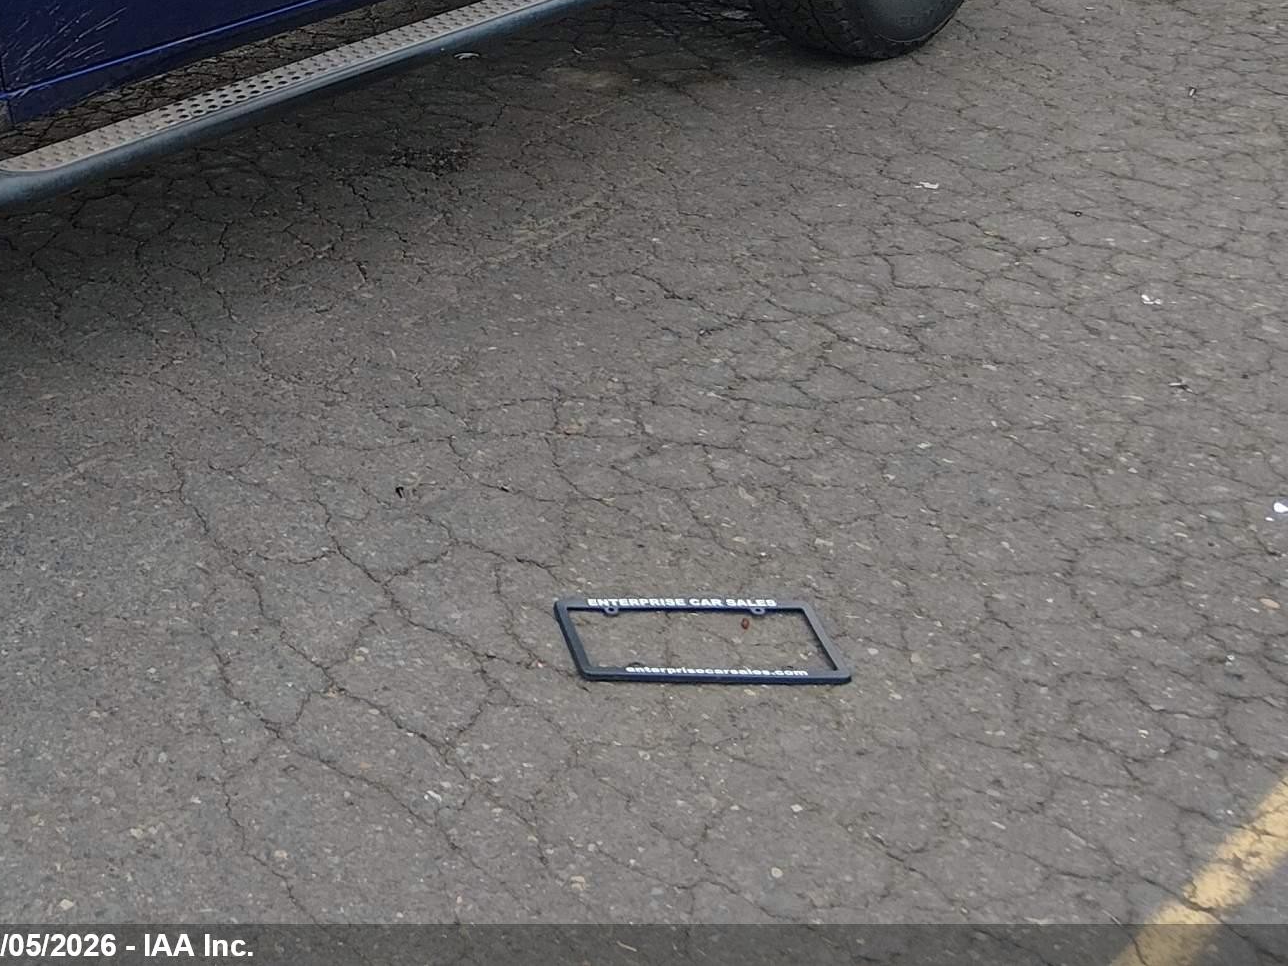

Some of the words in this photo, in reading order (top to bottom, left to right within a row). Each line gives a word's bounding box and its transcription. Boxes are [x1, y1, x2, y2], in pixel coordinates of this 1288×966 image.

[587, 598, 686, 608] ENTERPRISE
[688, 598, 724, 608] CAR
[725, 598, 778, 608] SALES
[625, 666, 809, 677] enterprisecarsales.com
